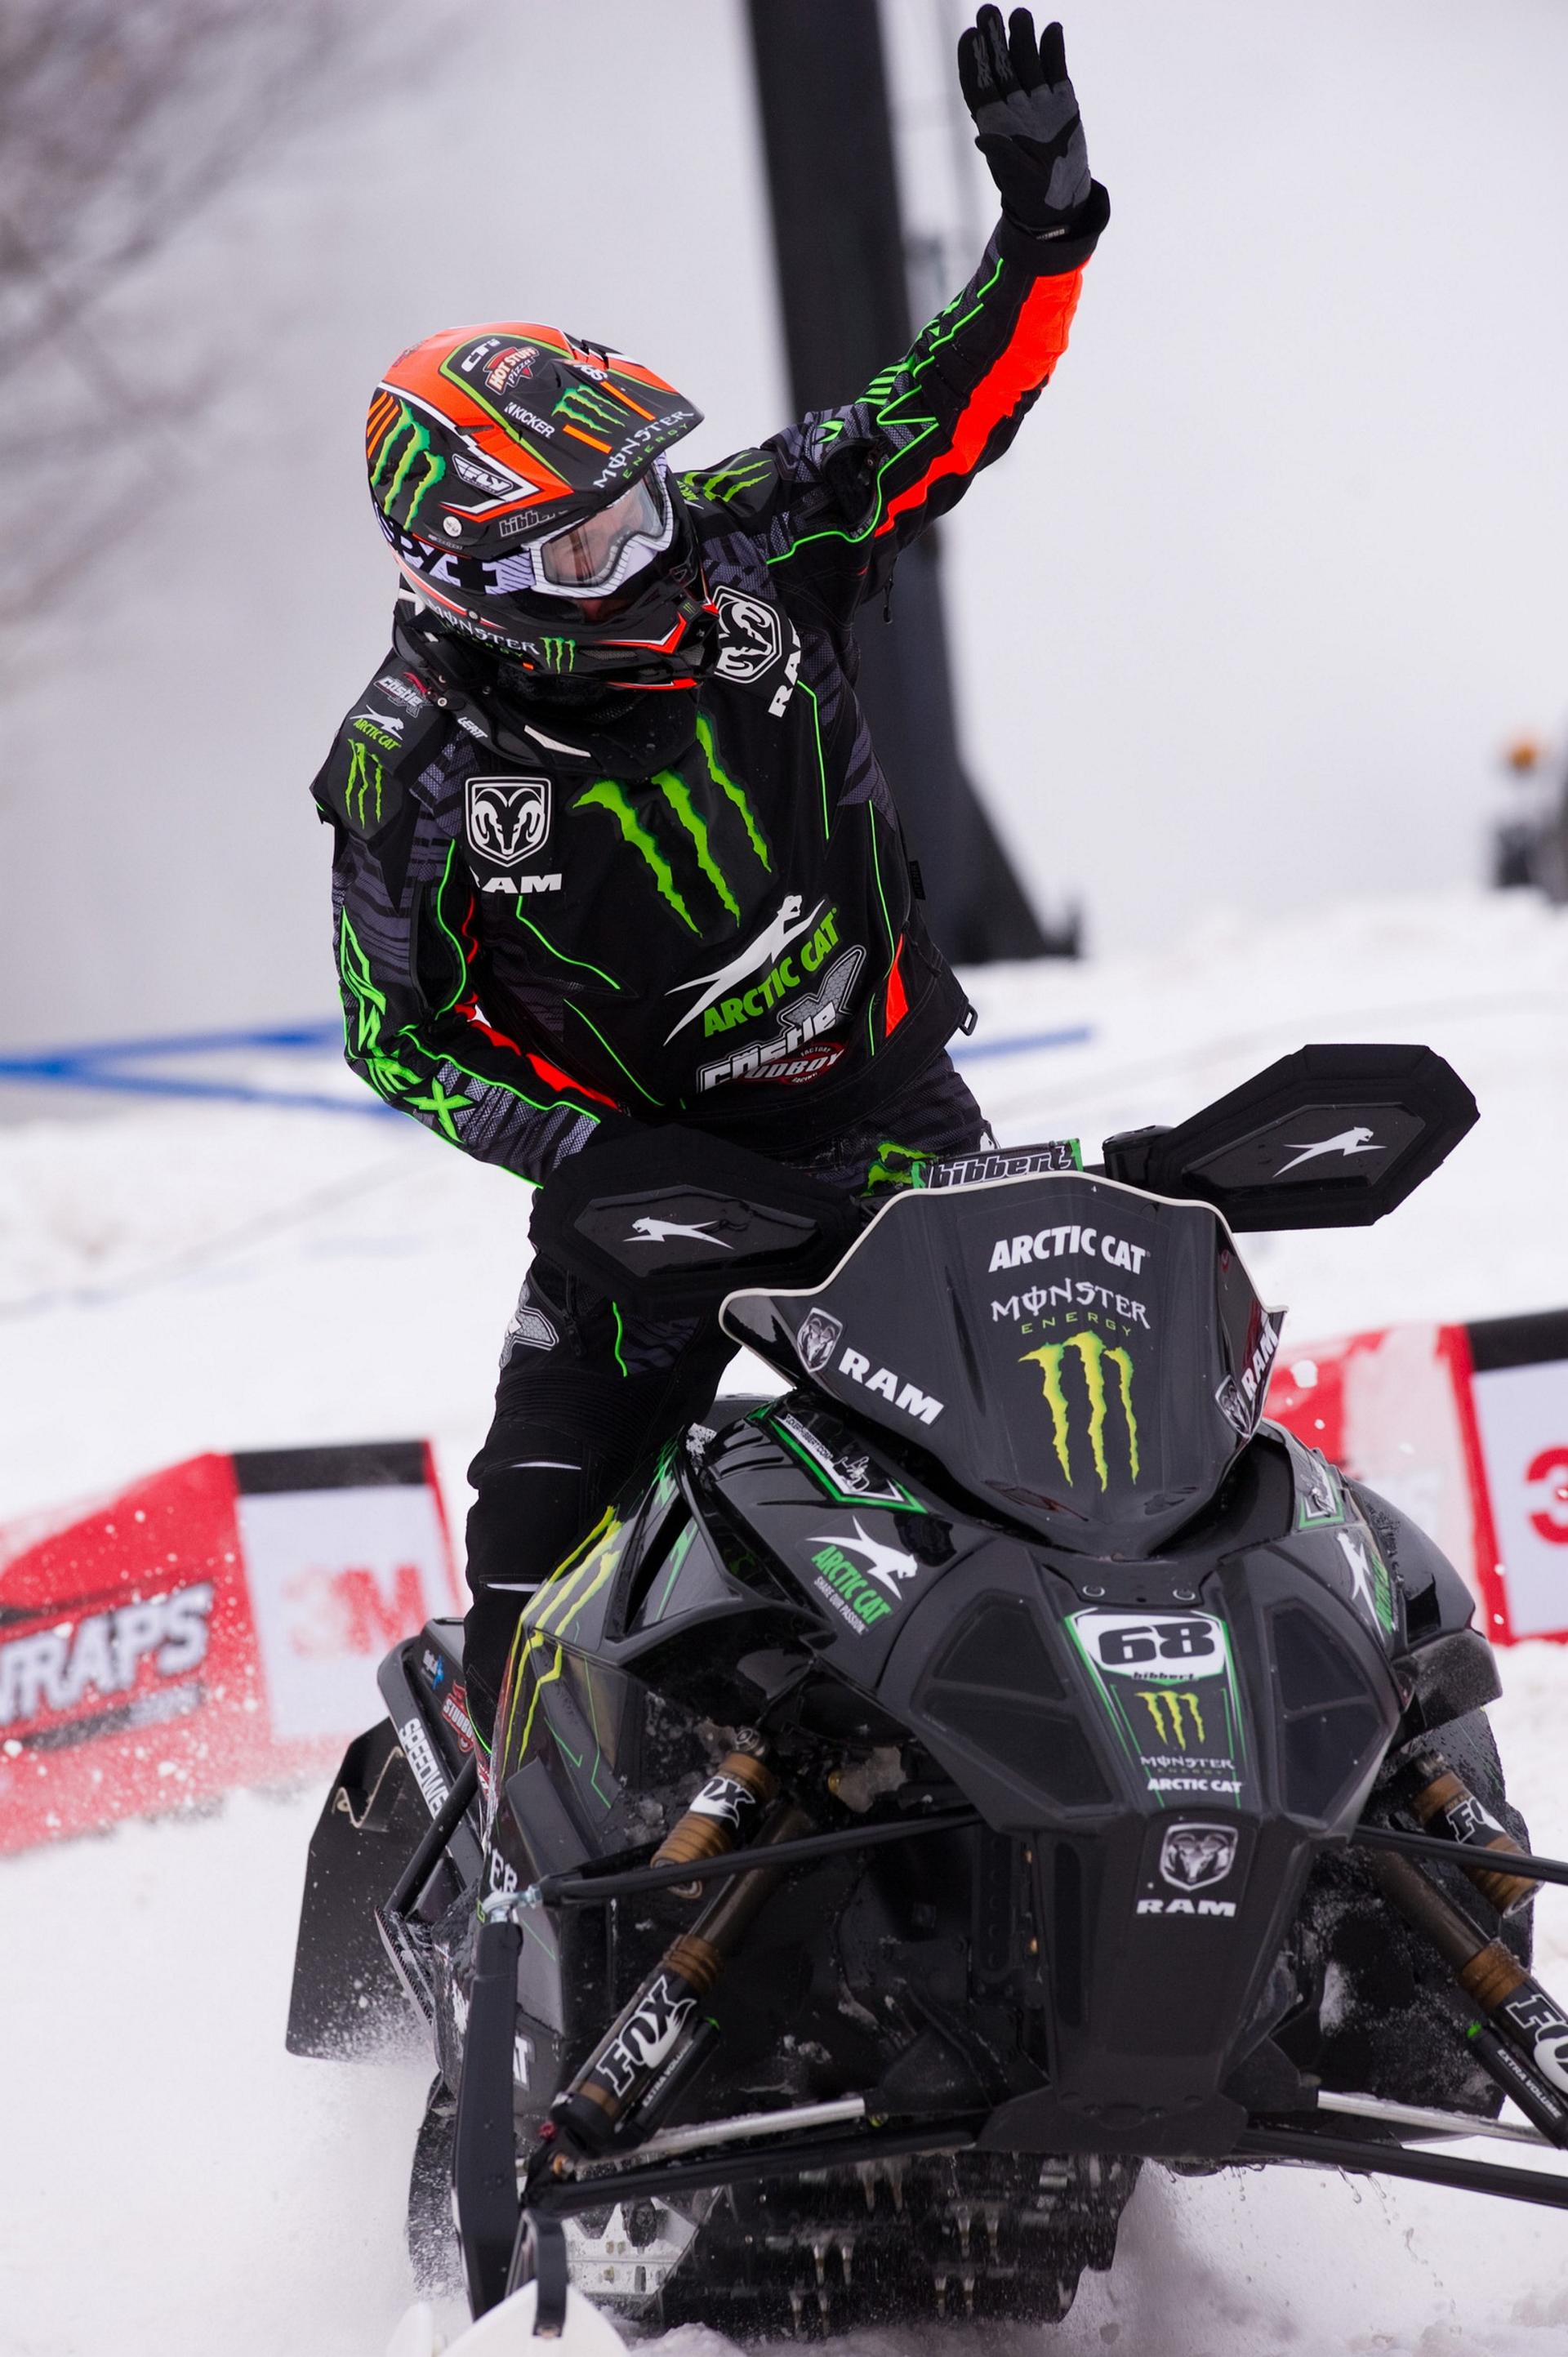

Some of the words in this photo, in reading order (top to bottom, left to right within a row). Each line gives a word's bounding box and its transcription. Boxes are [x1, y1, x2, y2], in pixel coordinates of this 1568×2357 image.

[489, 362, 510, 391] HOT
[504, 348, 537, 367] STUFF
[510, 406, 555, 439] KICKER
[593, 411, 694, 488] MONSTER
[623, 423, 688, 479] ENERGY
[455, 457, 510, 491] FLY
[499, 510, 569, 537] hibb
[426, 599, 540, 654] MONSTER
[353, 718, 383, 740] ARCTIC
[378, 735, 399, 750] CAT
[470, 866, 562, 893] AM
[705, 956, 800, 1037] ARCTIC
[800, 911, 839, 972] CAT
[742, 1049, 844, 1079] UDBOY
[988, 1225, 1097, 1272] ARCTIC
[1101, 1235, 1146, 1274] CAT
[990, 1277, 1151, 1330] MONSTER
[1021, 1312, 1131, 1336] ENERGY
[1241, 1308, 1279, 1401] RAM
[838, 1348, 944, 1425] RAM
[1524, 1445, 1568, 1546] 3
[811, 1544, 868, 1600] ARCTIC
[853, 1589, 892, 1624] CAT
[813, 1575, 835, 1598] SHARE
[829, 1593, 845, 1610] OUR
[1098, 1621, 1215, 1665] 68
[443, 1698, 474, 1738] STUDBO
[399, 1718, 450, 1820] SPEEDWE
[1140, 1755, 1236, 1771] MONSTER
[693, 1776, 755, 1817] OX
[1147, 1778, 1209, 1791] ARCTIC
[1210, 1780, 1242, 1793] CAT
[1137, 1899, 1236, 1917] RAM
[596, 1975, 697, 2097] FOX
[642, 2075, 667, 2107] EXTRA
[1497, 2048, 1527, 2080] EXTRA
[1525, 2079, 1562, 2119] VOLUME
